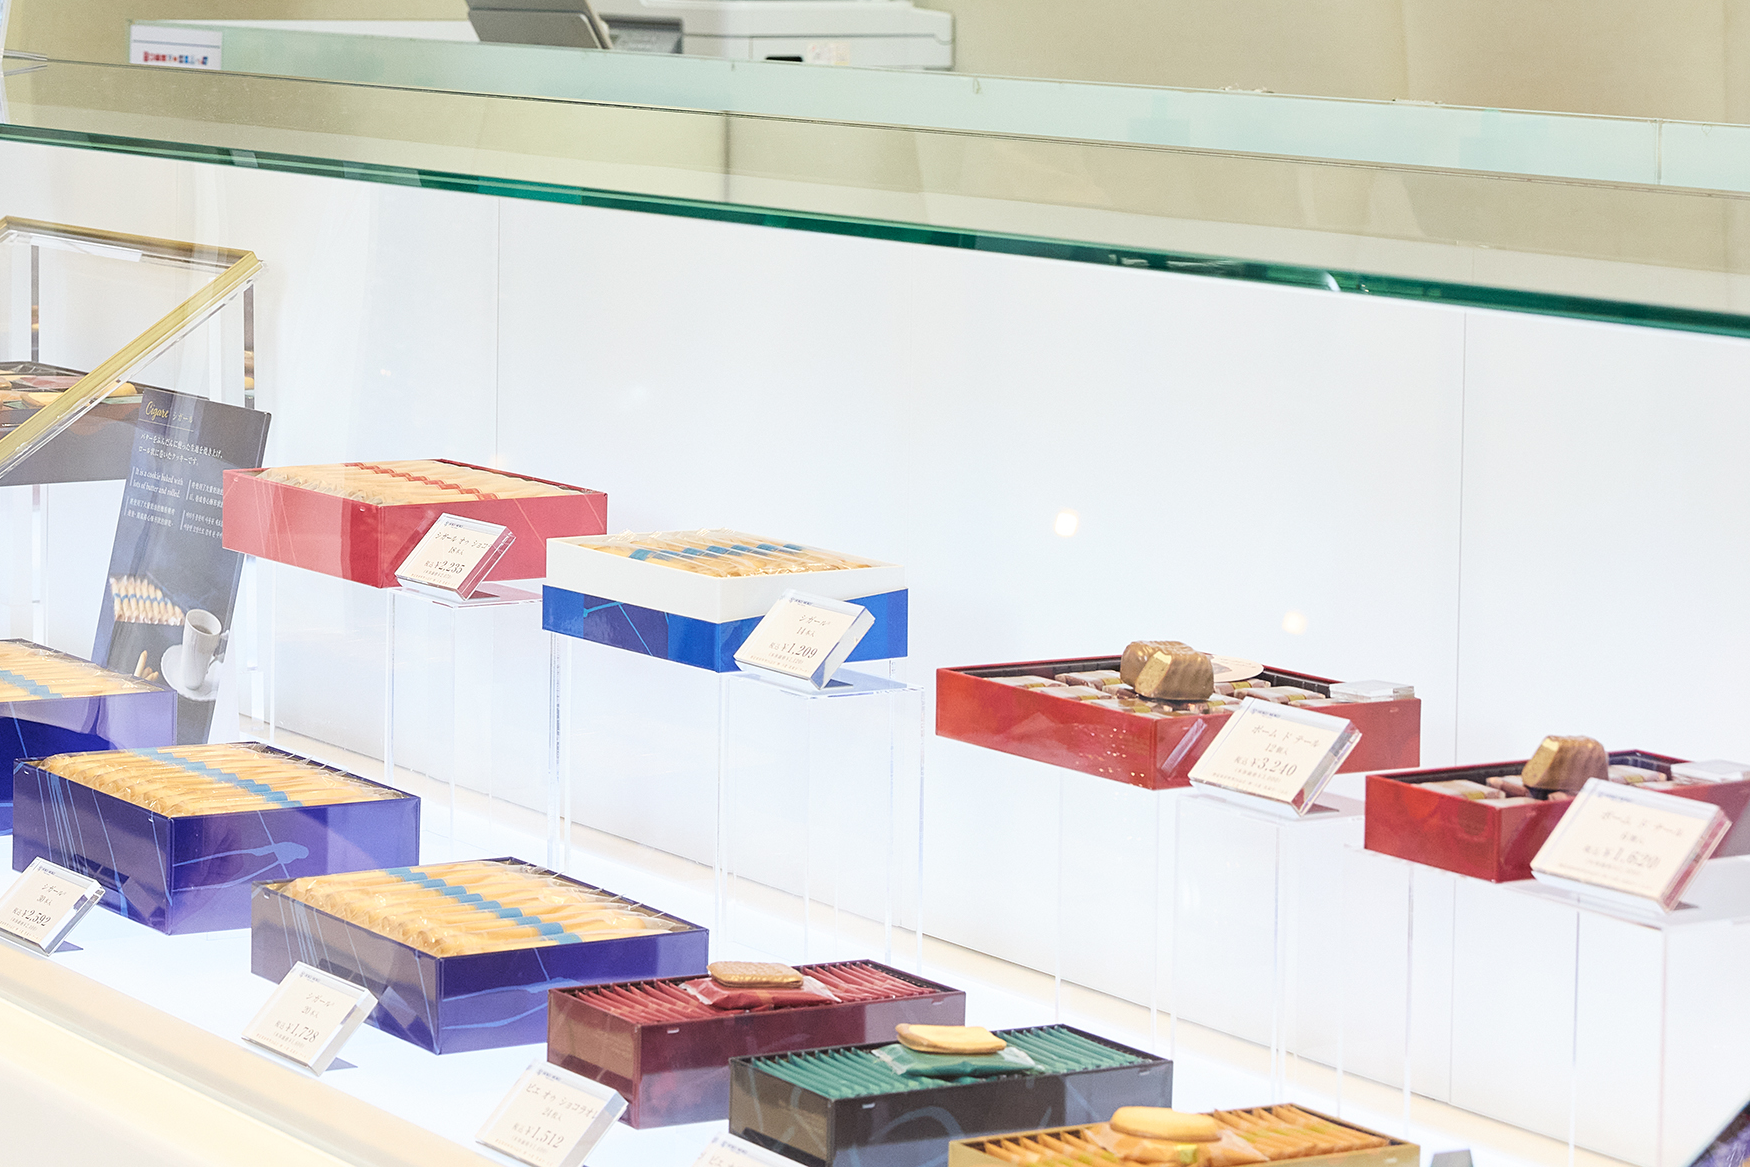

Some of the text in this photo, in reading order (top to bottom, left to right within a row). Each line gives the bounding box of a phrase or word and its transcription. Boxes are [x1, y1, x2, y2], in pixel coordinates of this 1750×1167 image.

[145, 400, 194, 424] Cigare シガール
